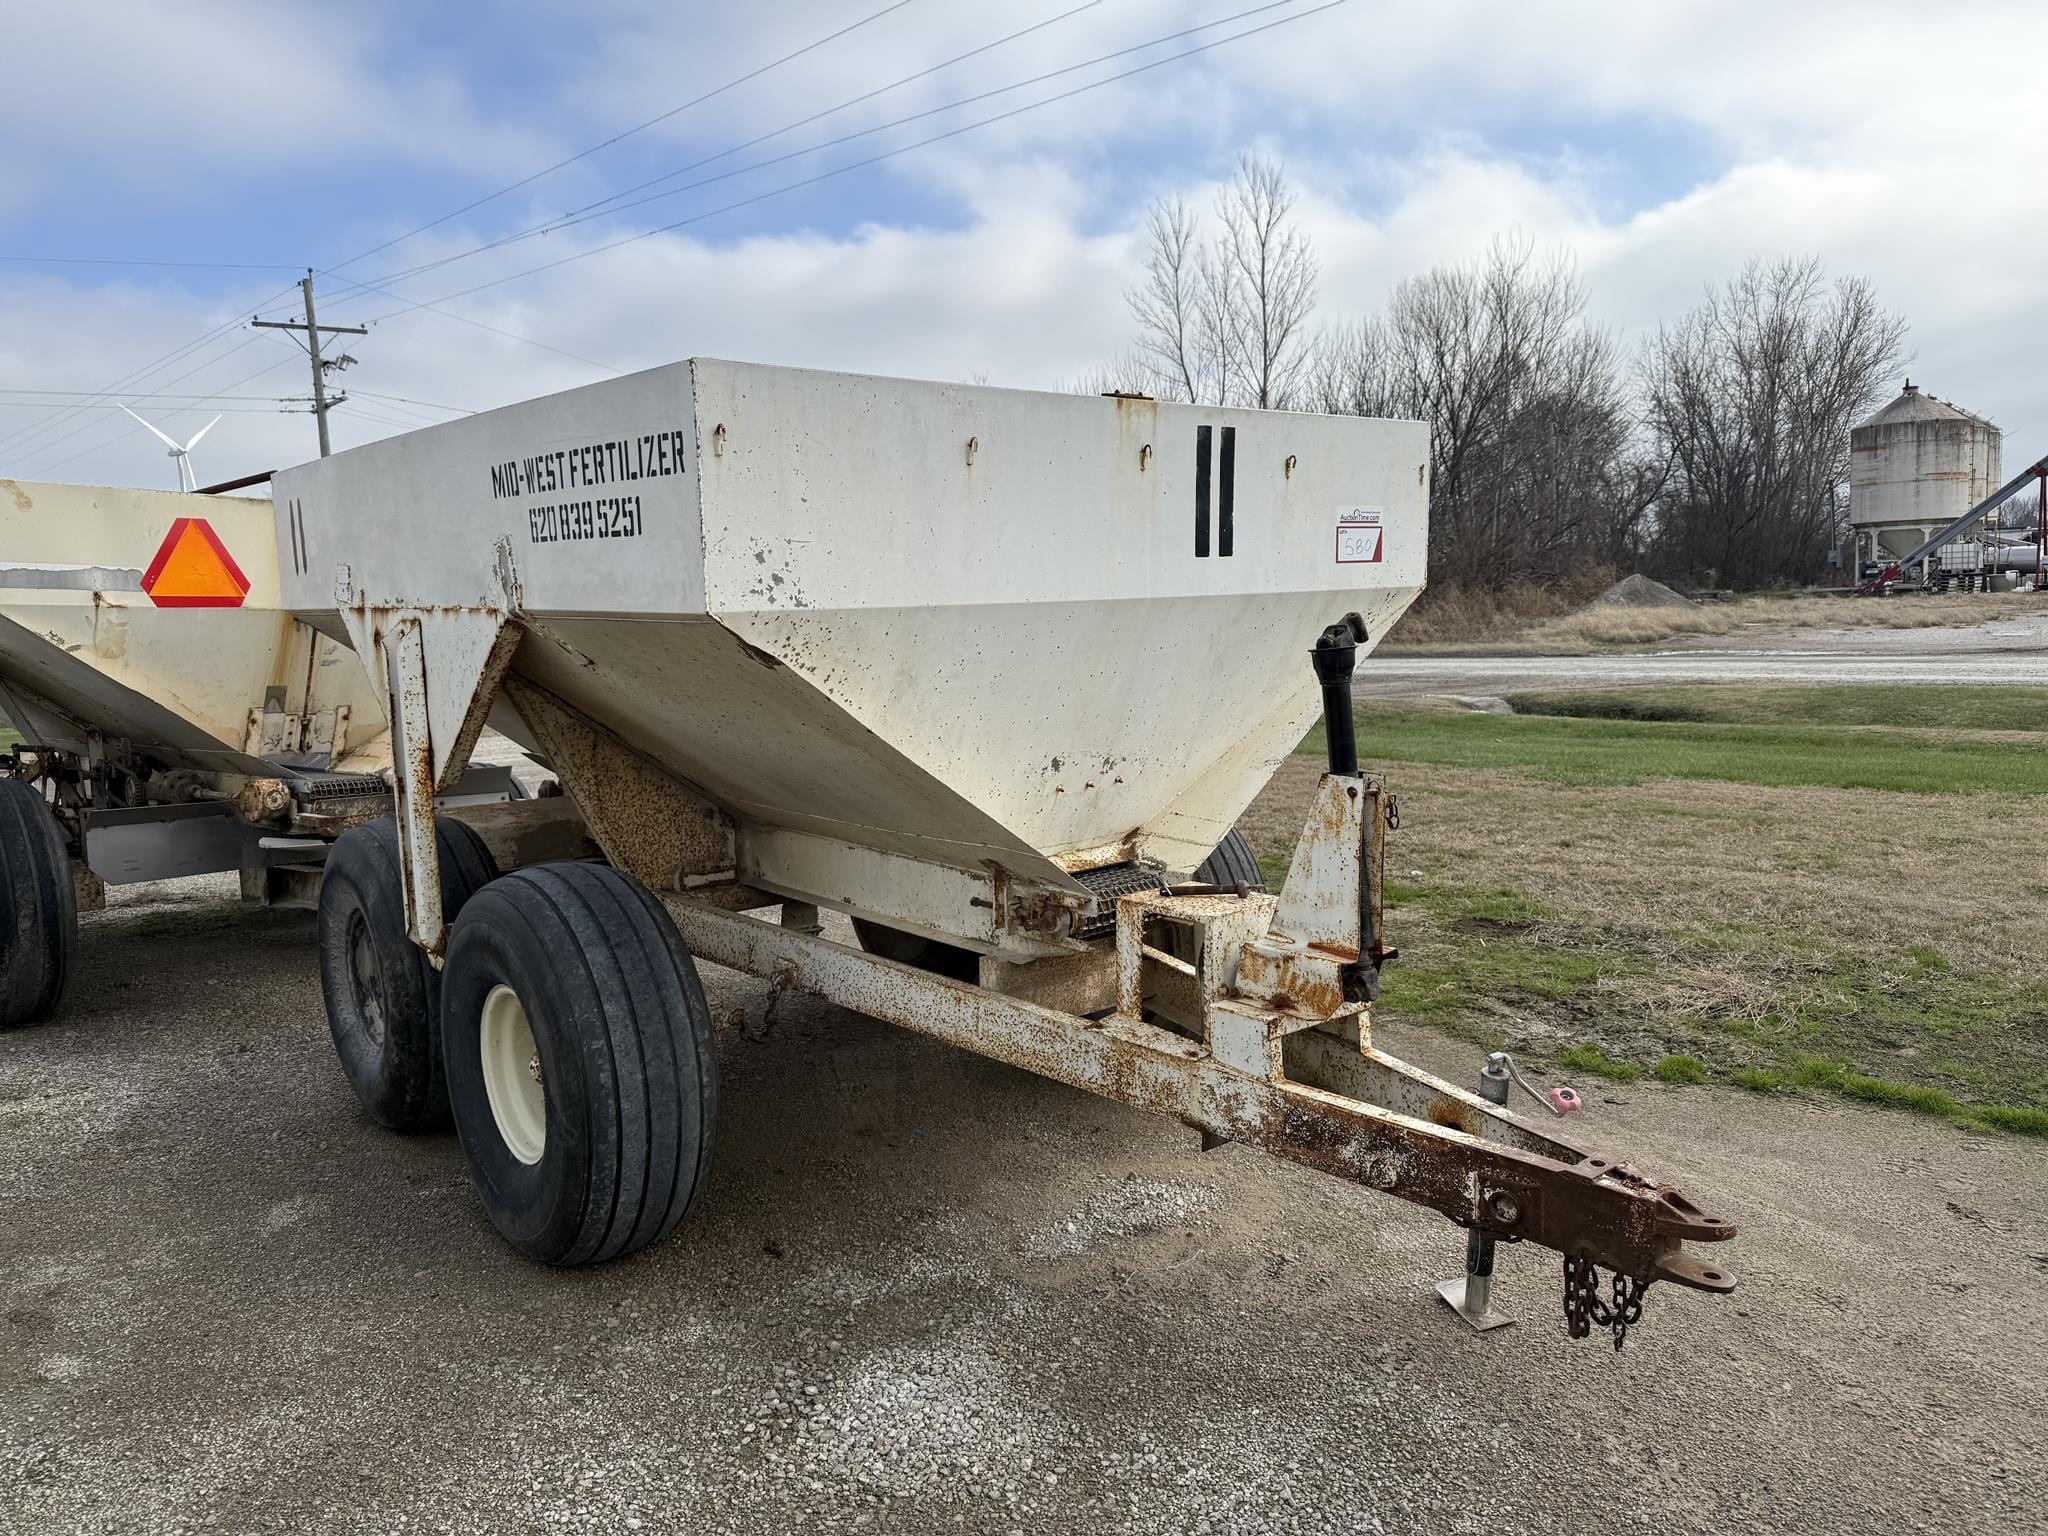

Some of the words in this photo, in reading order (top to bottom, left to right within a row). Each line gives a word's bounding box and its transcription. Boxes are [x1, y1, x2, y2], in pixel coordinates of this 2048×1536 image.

[491, 451, 565, 499] MID-WEST
[569, 430, 686, 488] FERTILIZER
[528, 505, 558, 543] 620
[558, 500, 595, 541] 839
[596, 495, 642, 539] 5251
[1345, 537, 1373, 556] 580
